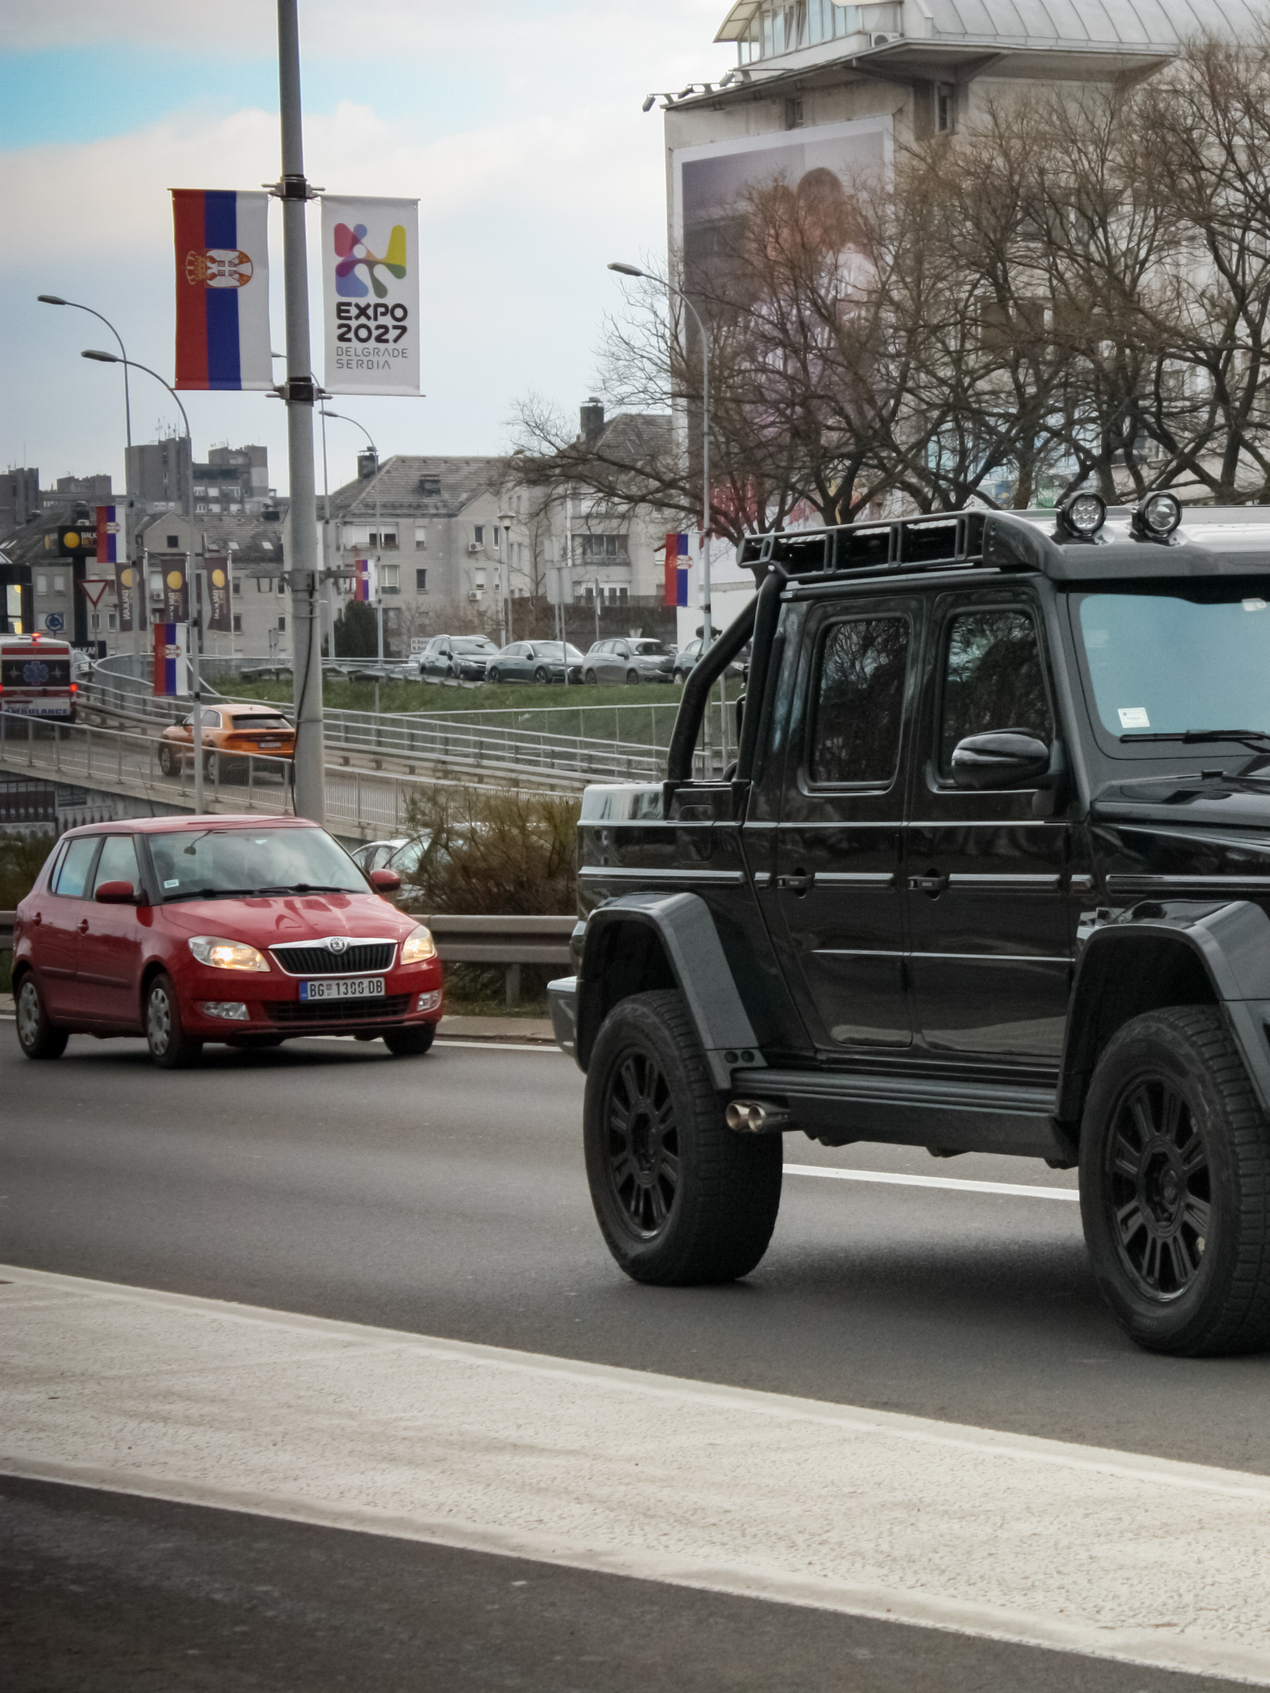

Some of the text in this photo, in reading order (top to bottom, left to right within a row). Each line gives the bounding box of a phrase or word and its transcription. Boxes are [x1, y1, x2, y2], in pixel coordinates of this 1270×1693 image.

[336, 302, 408, 322] EXPO
[336, 323, 408, 344] 2027
[336, 346, 409, 358] BELGRADE
[336, 359, 391, 370] SERBIA
[309, 983, 325, 998] BG
